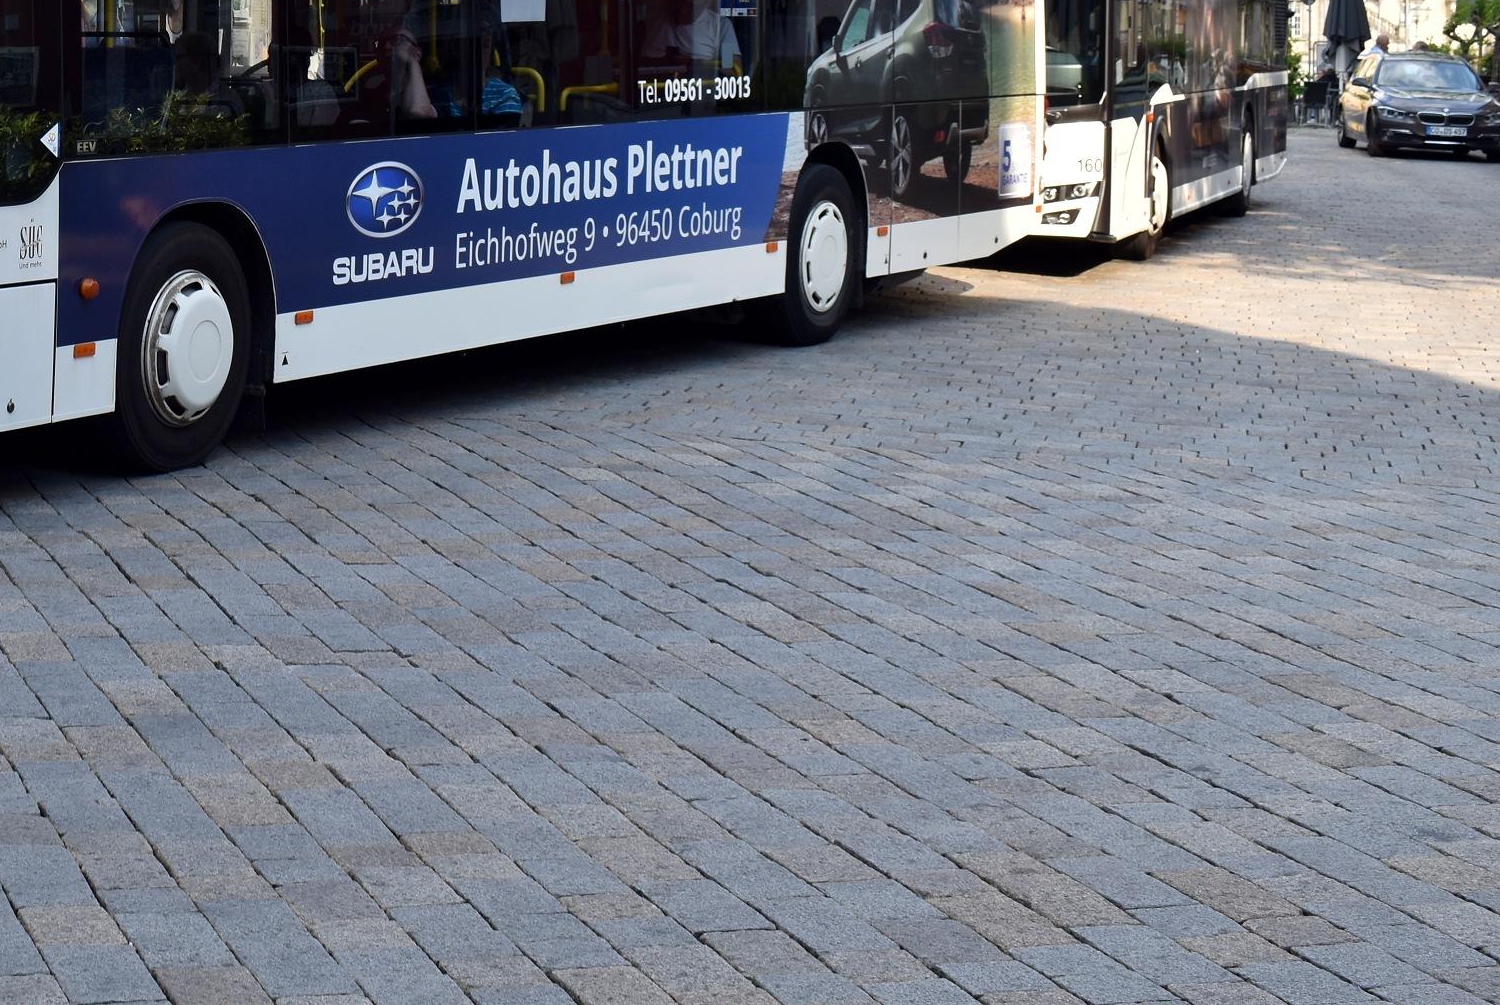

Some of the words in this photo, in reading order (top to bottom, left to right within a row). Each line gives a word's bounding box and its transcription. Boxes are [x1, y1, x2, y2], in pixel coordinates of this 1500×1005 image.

[638, 80, 661, 104] Tel.
[664, 78, 703, 102] 09561
[714, 75, 751, 100] 30013
[77, 141, 97, 152] EEV
[1002, 140, 1011, 172] 5
[457, 149, 618, 213] Autohaus
[627, 141, 743, 195] Plettner
[1077, 158, 1102, 172] 160
[455, 220, 578, 269] Eichhofweg
[584, 218, 595, 252] 9
[615, 208, 672, 248] 96450
[678, 203, 742, 240] Coburg
[18, 261, 29, 270] Und
[332, 246, 435, 286] SUBARU
